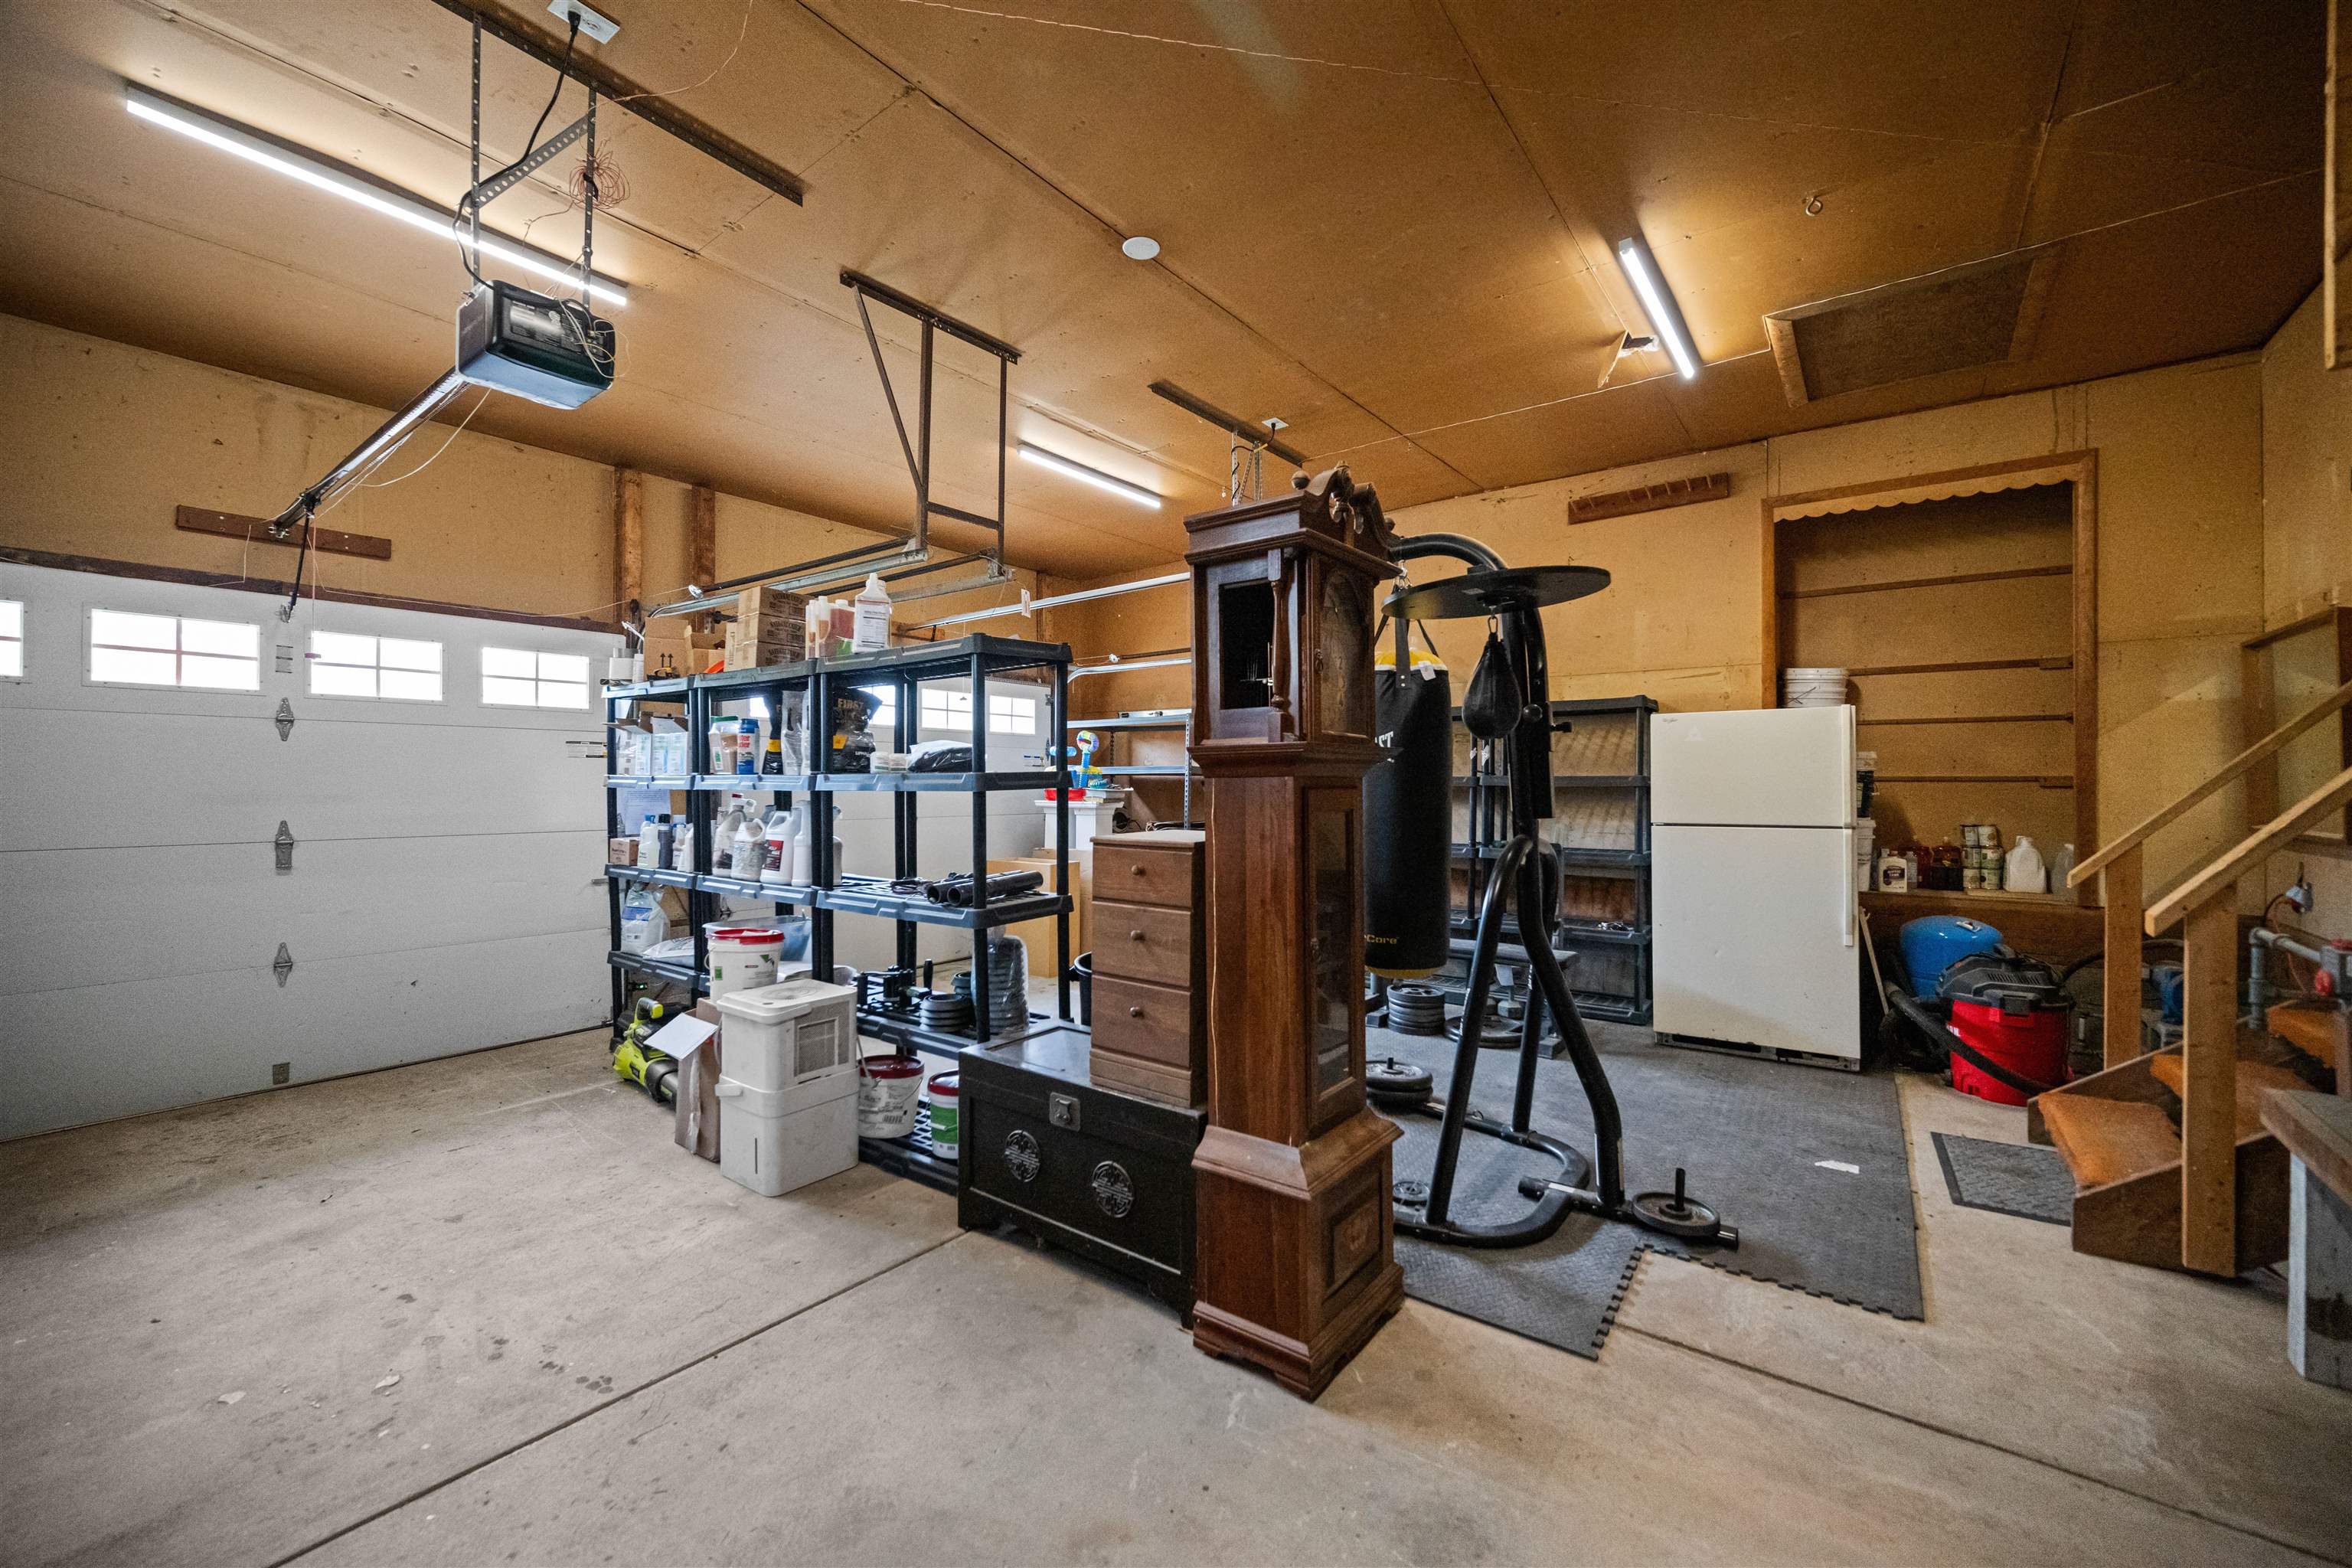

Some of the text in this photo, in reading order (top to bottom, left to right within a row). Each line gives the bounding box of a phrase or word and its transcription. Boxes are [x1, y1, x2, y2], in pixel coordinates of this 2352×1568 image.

[838, 697, 864, 709] FIRST
[1374, 731, 1393, 747] ST
[1364, 933, 1397, 944] Core
